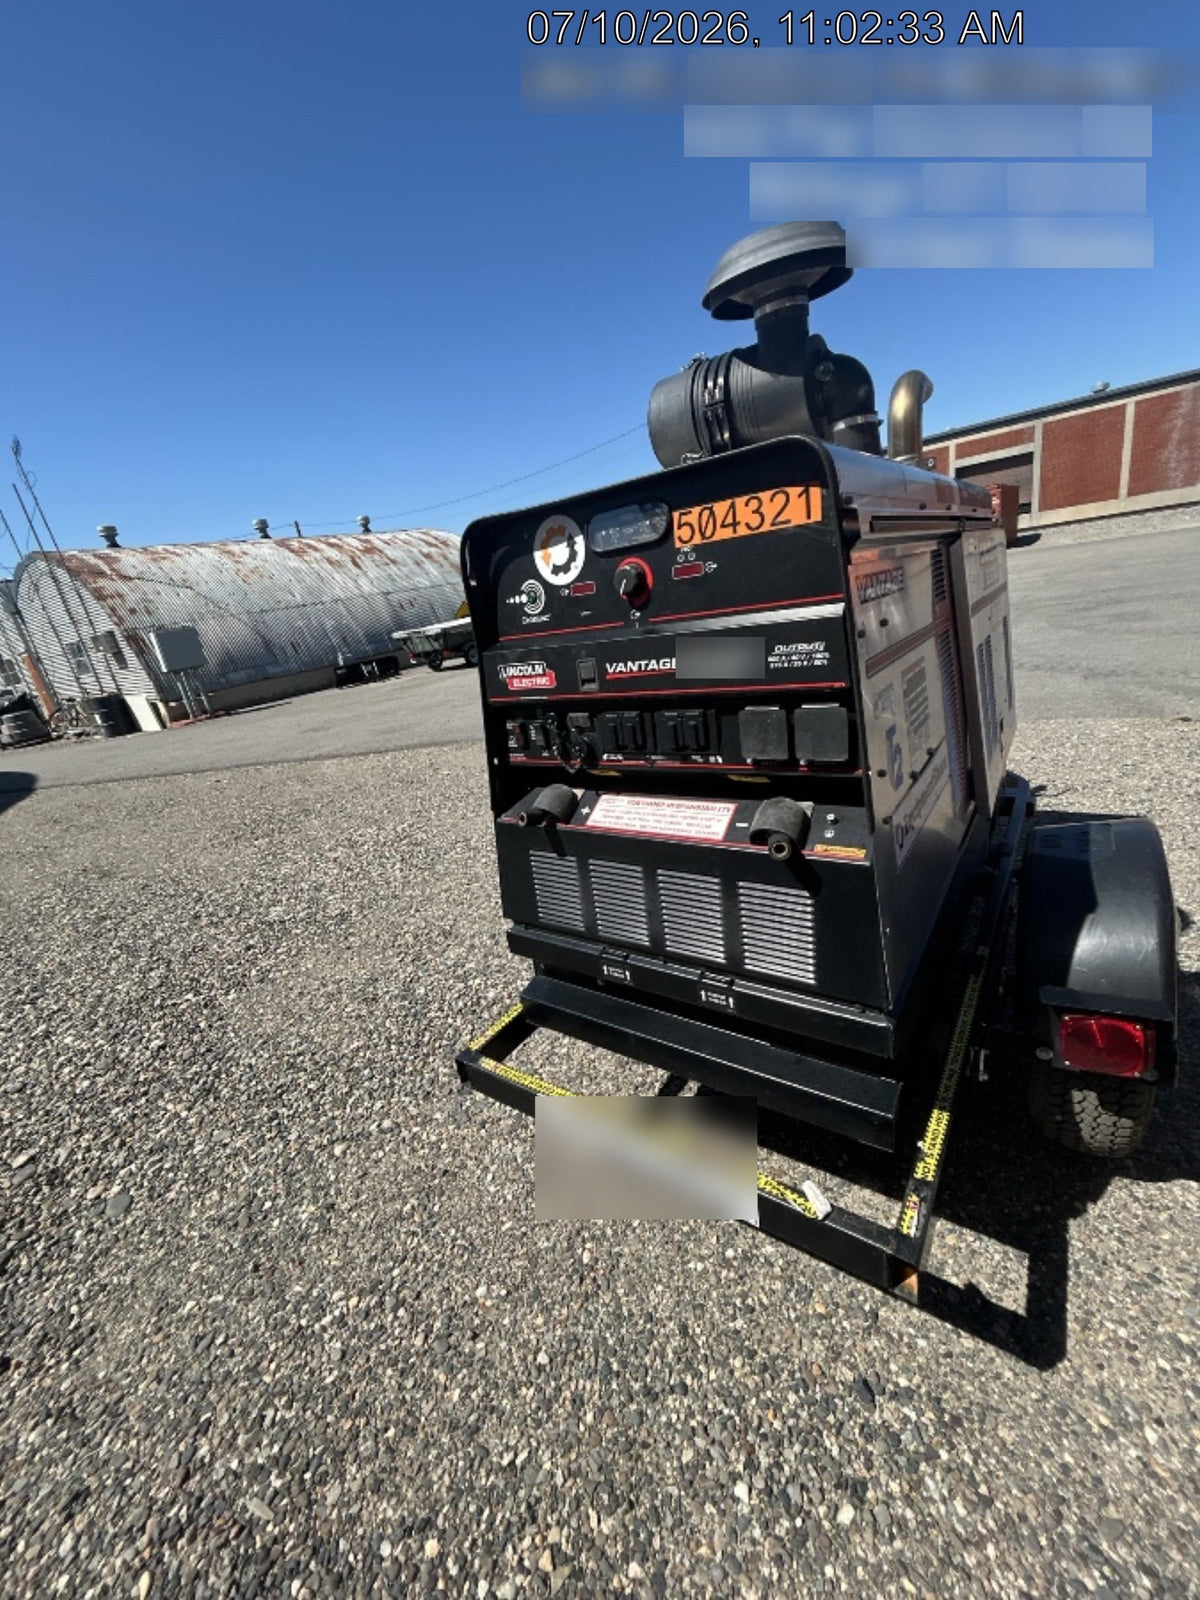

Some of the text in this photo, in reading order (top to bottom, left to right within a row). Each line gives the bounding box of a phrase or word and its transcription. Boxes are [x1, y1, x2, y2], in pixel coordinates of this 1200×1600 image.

[676, 484, 812, 545] 504321
[498, 663, 545, 679] LINCOLN
[513, 676, 551, 688] ELECTRIC
